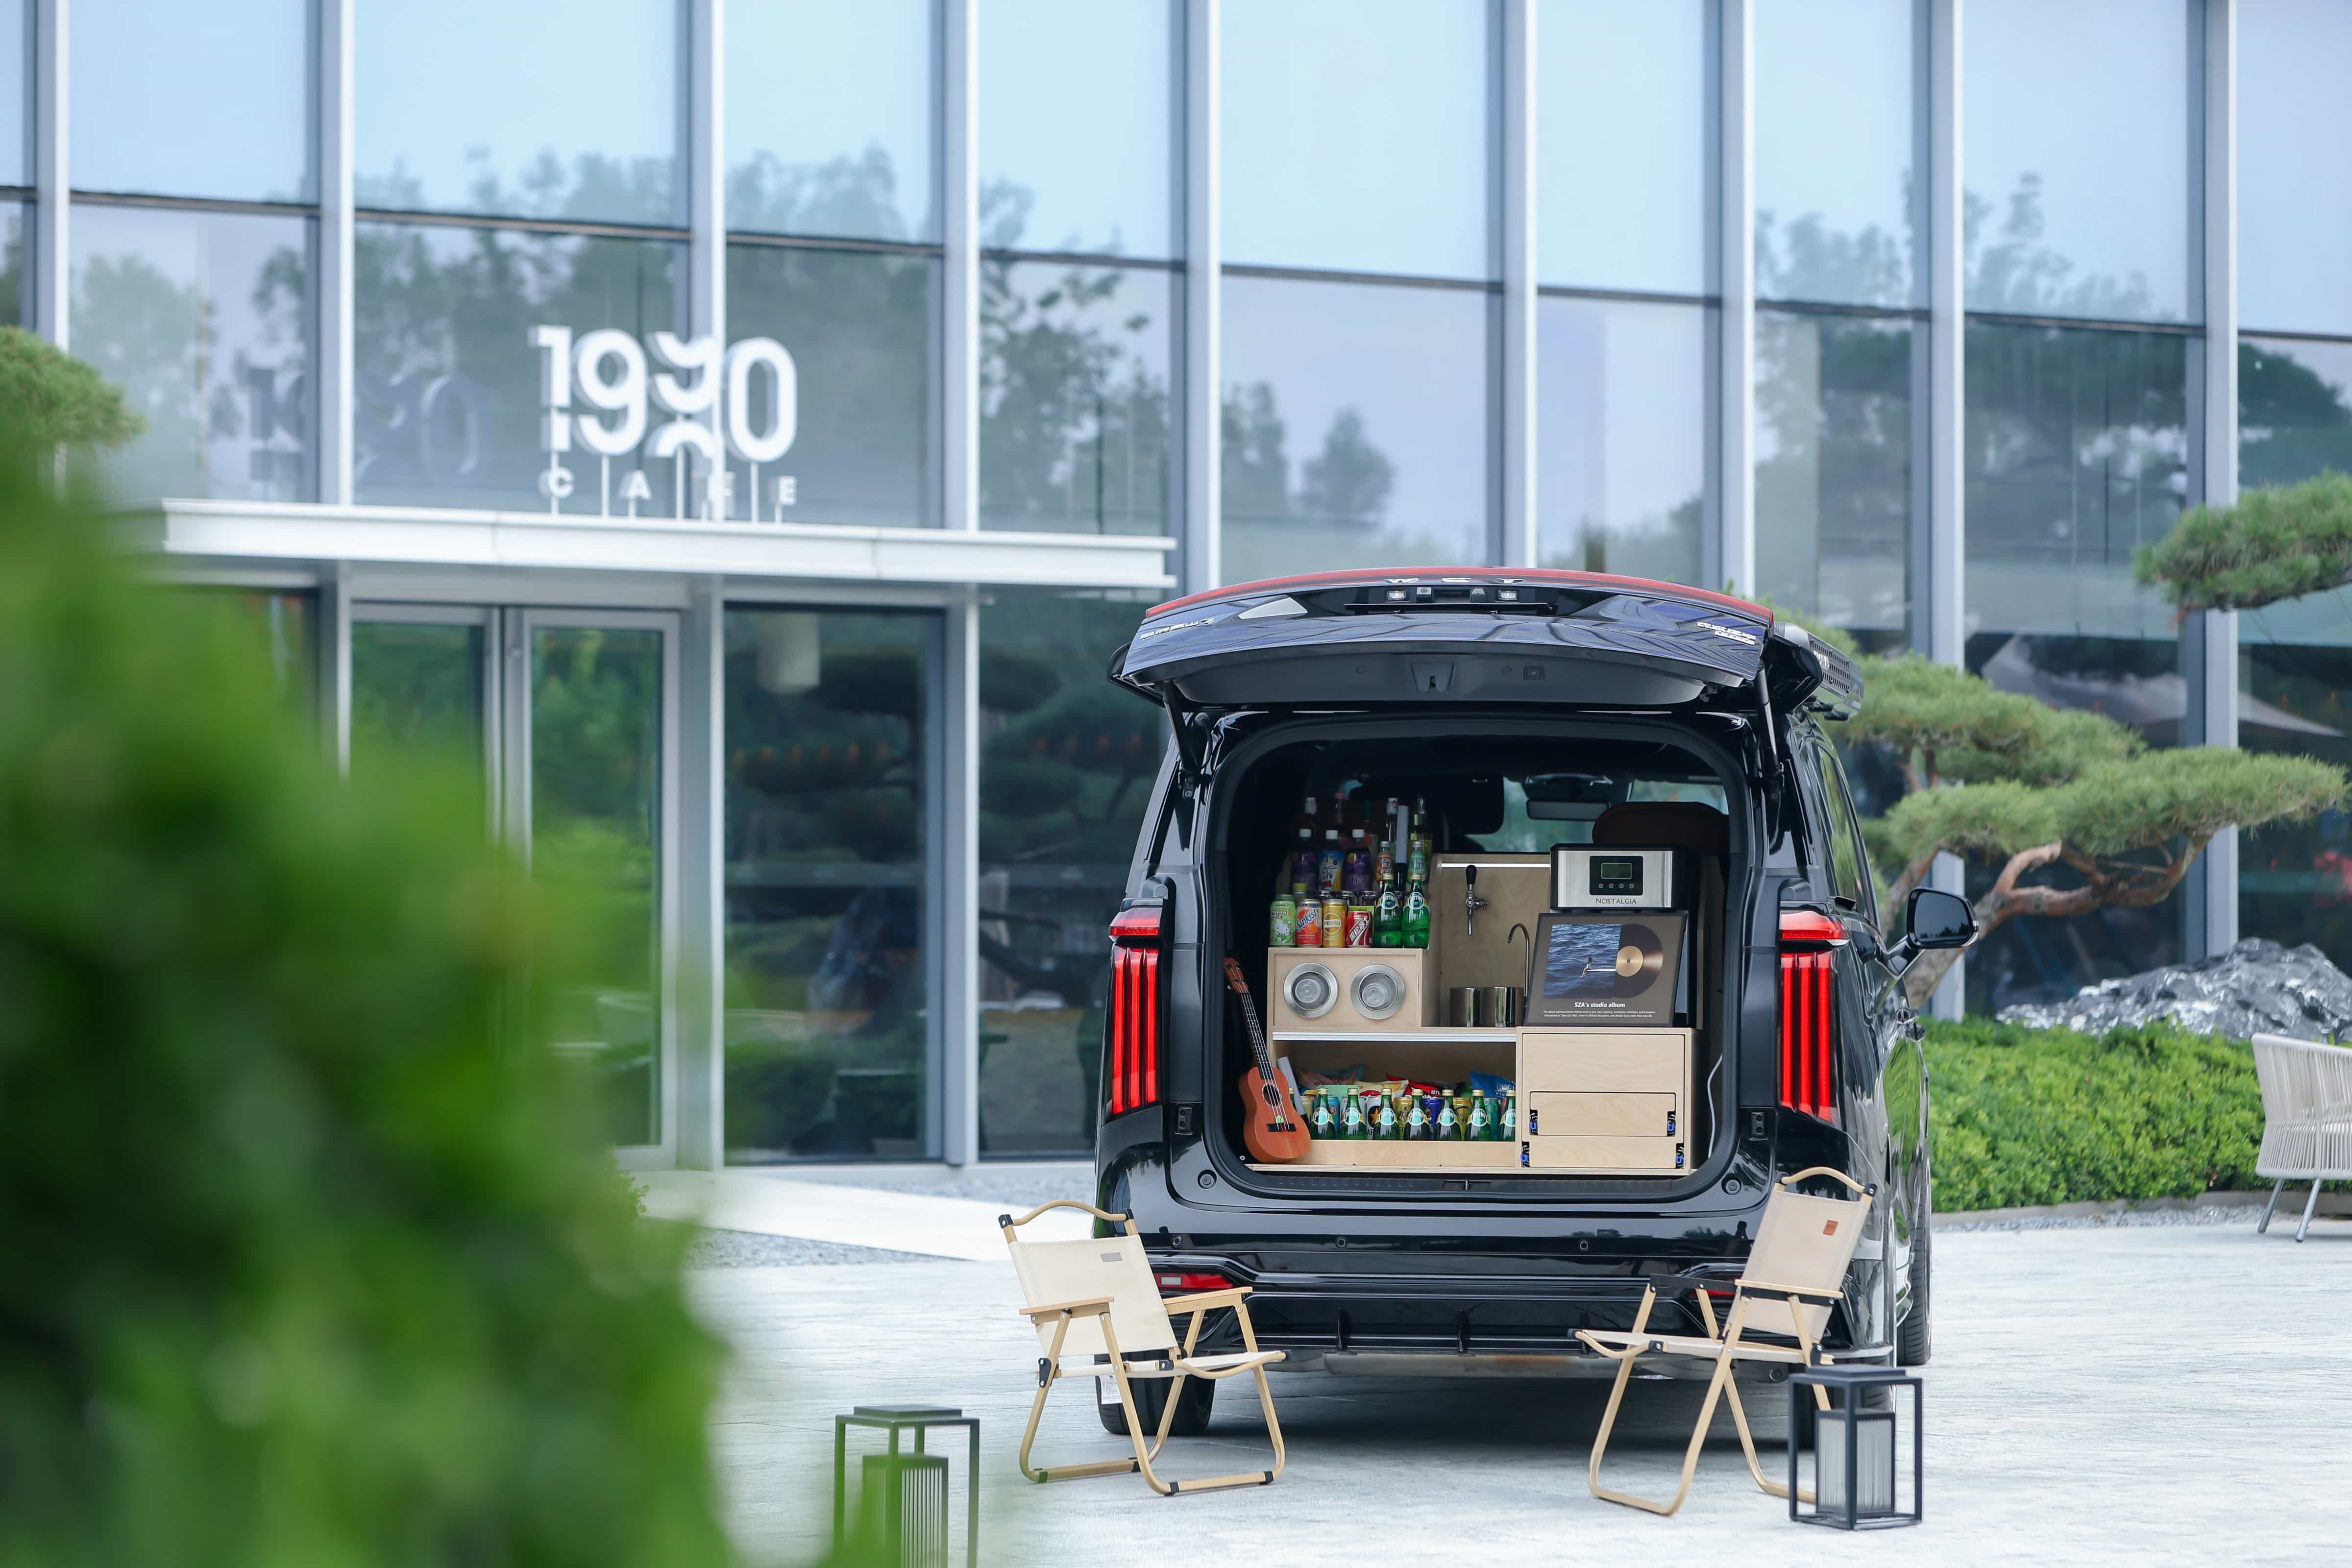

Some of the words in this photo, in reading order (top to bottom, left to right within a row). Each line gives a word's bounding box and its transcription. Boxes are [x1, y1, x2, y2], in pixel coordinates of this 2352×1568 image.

[529, 324, 798, 463] 1990
[540, 466, 797, 506] CAFE
[1297, 907, 1318, 931] Sunkist
